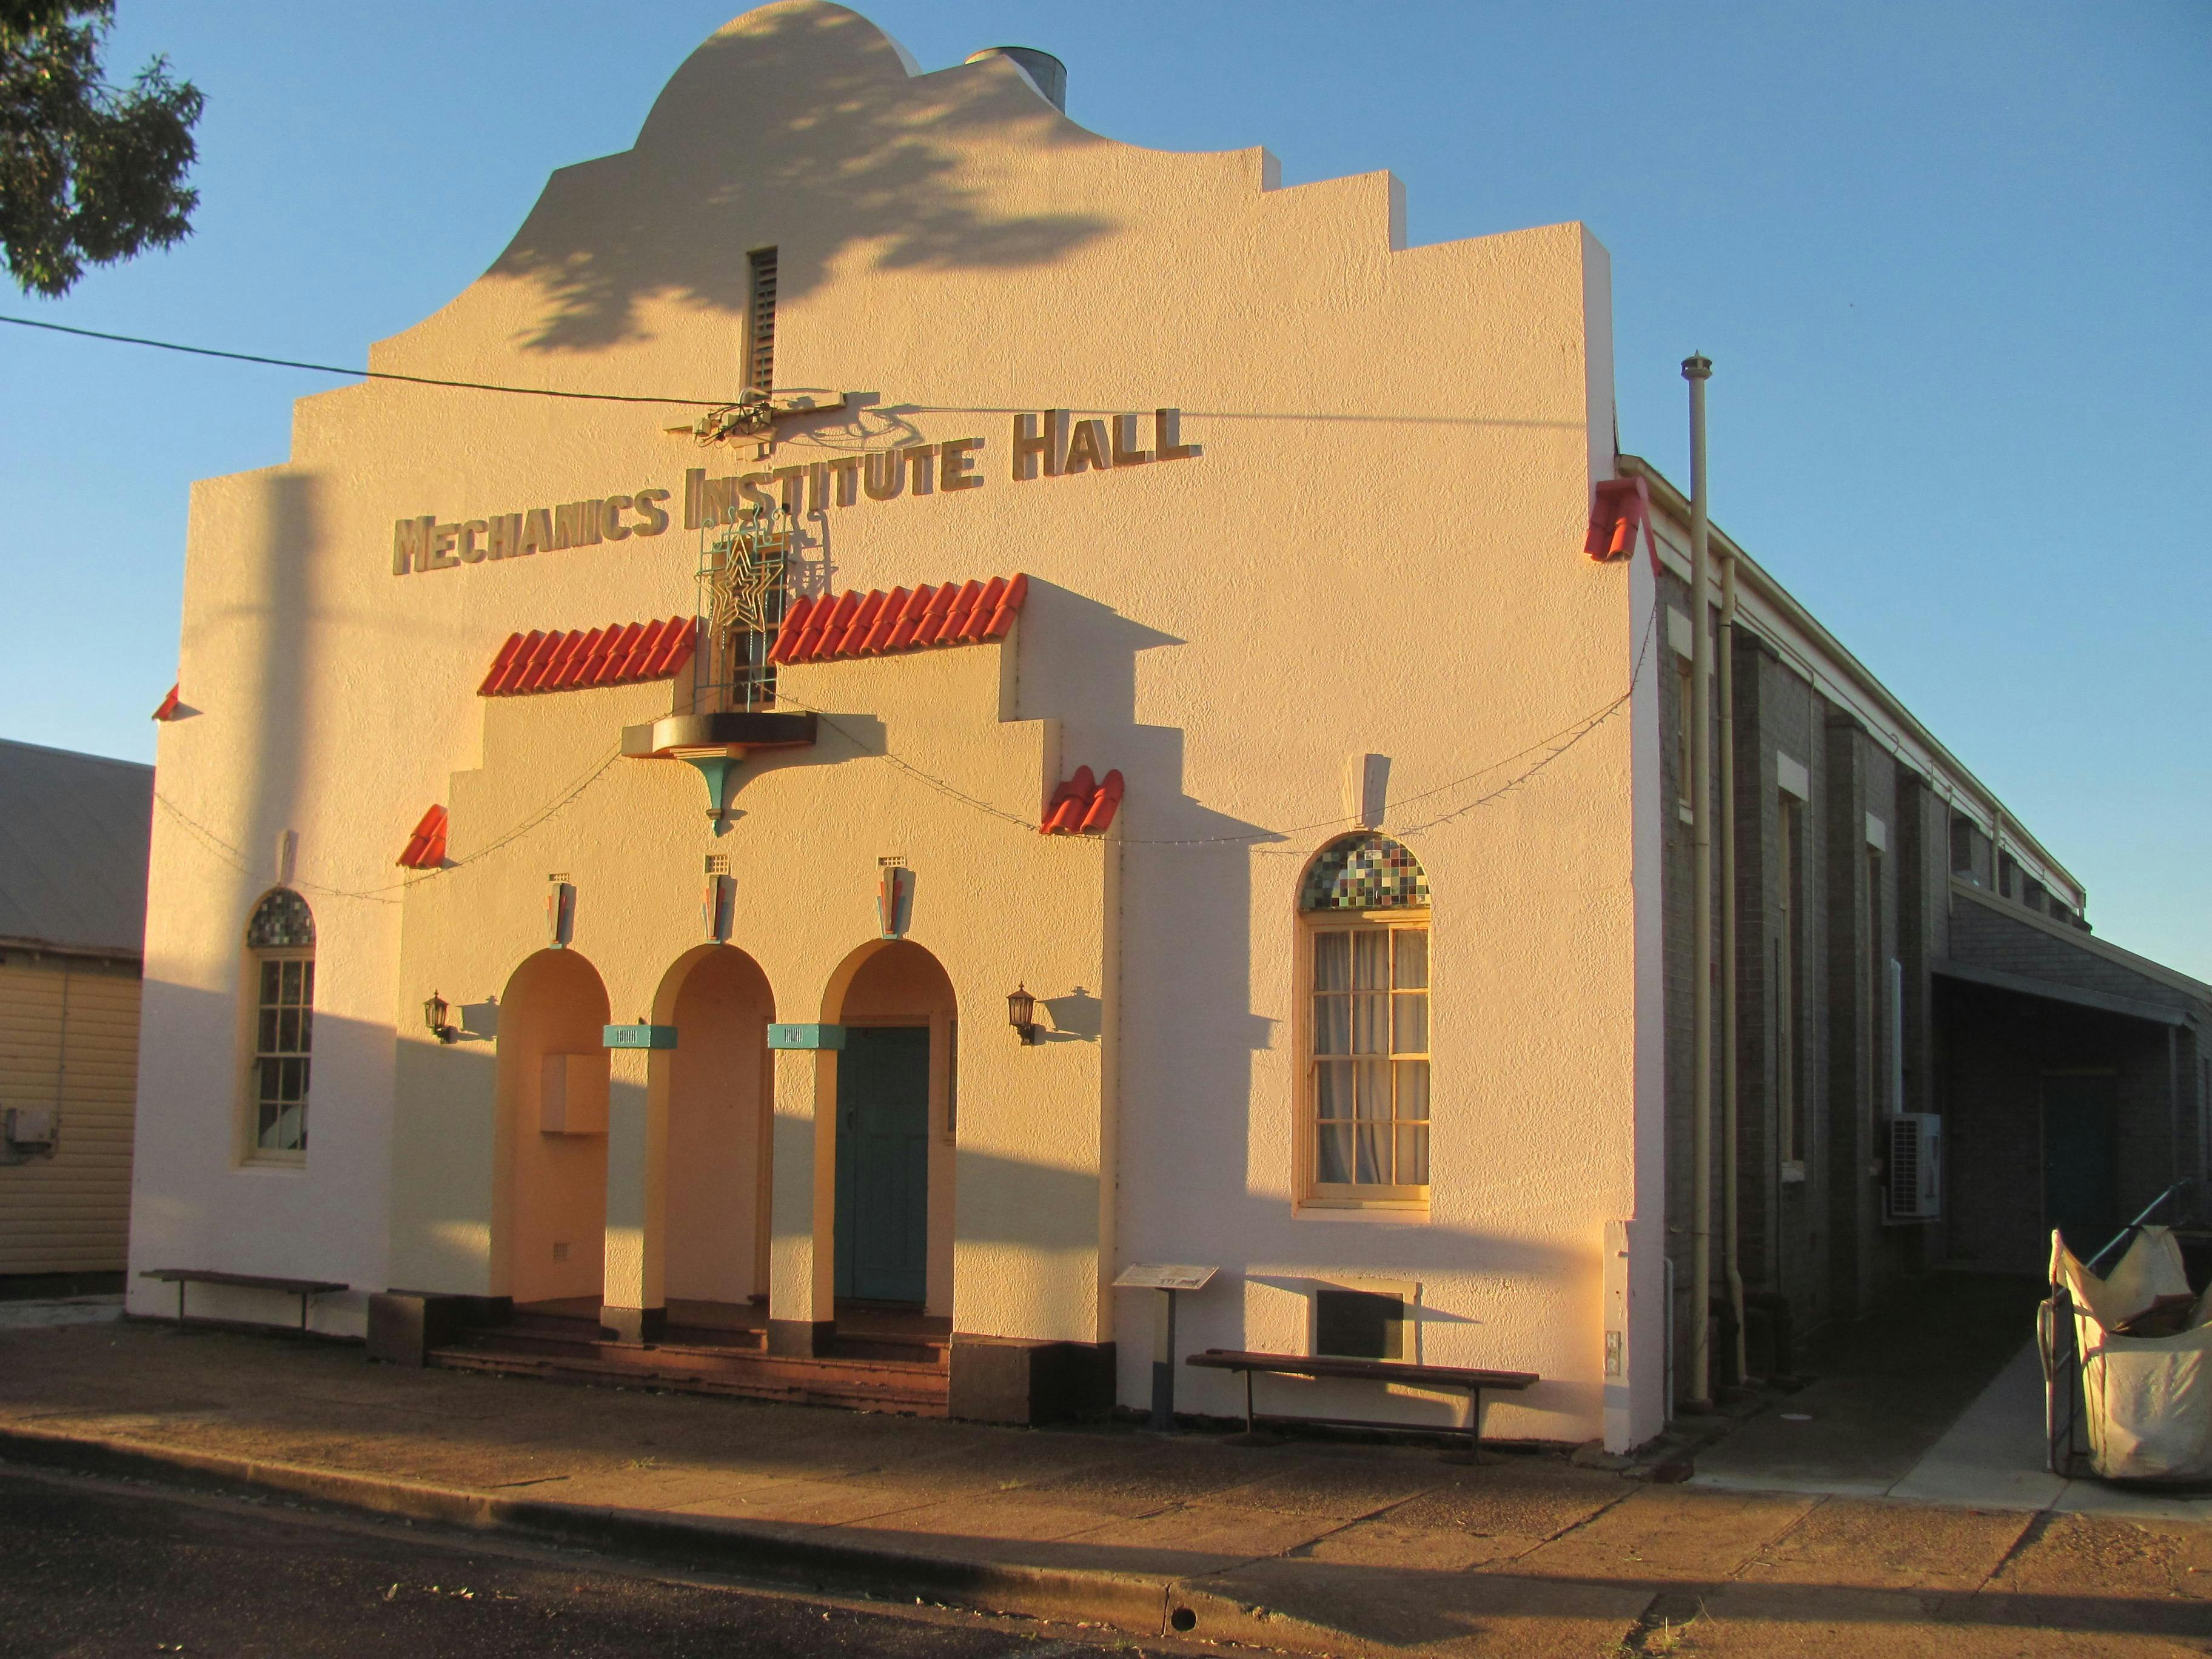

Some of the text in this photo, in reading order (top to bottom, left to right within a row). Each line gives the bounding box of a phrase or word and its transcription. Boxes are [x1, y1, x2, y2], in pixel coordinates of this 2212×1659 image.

[393, 408, 1202, 575] MECHANICS INSTITUTE HALL
